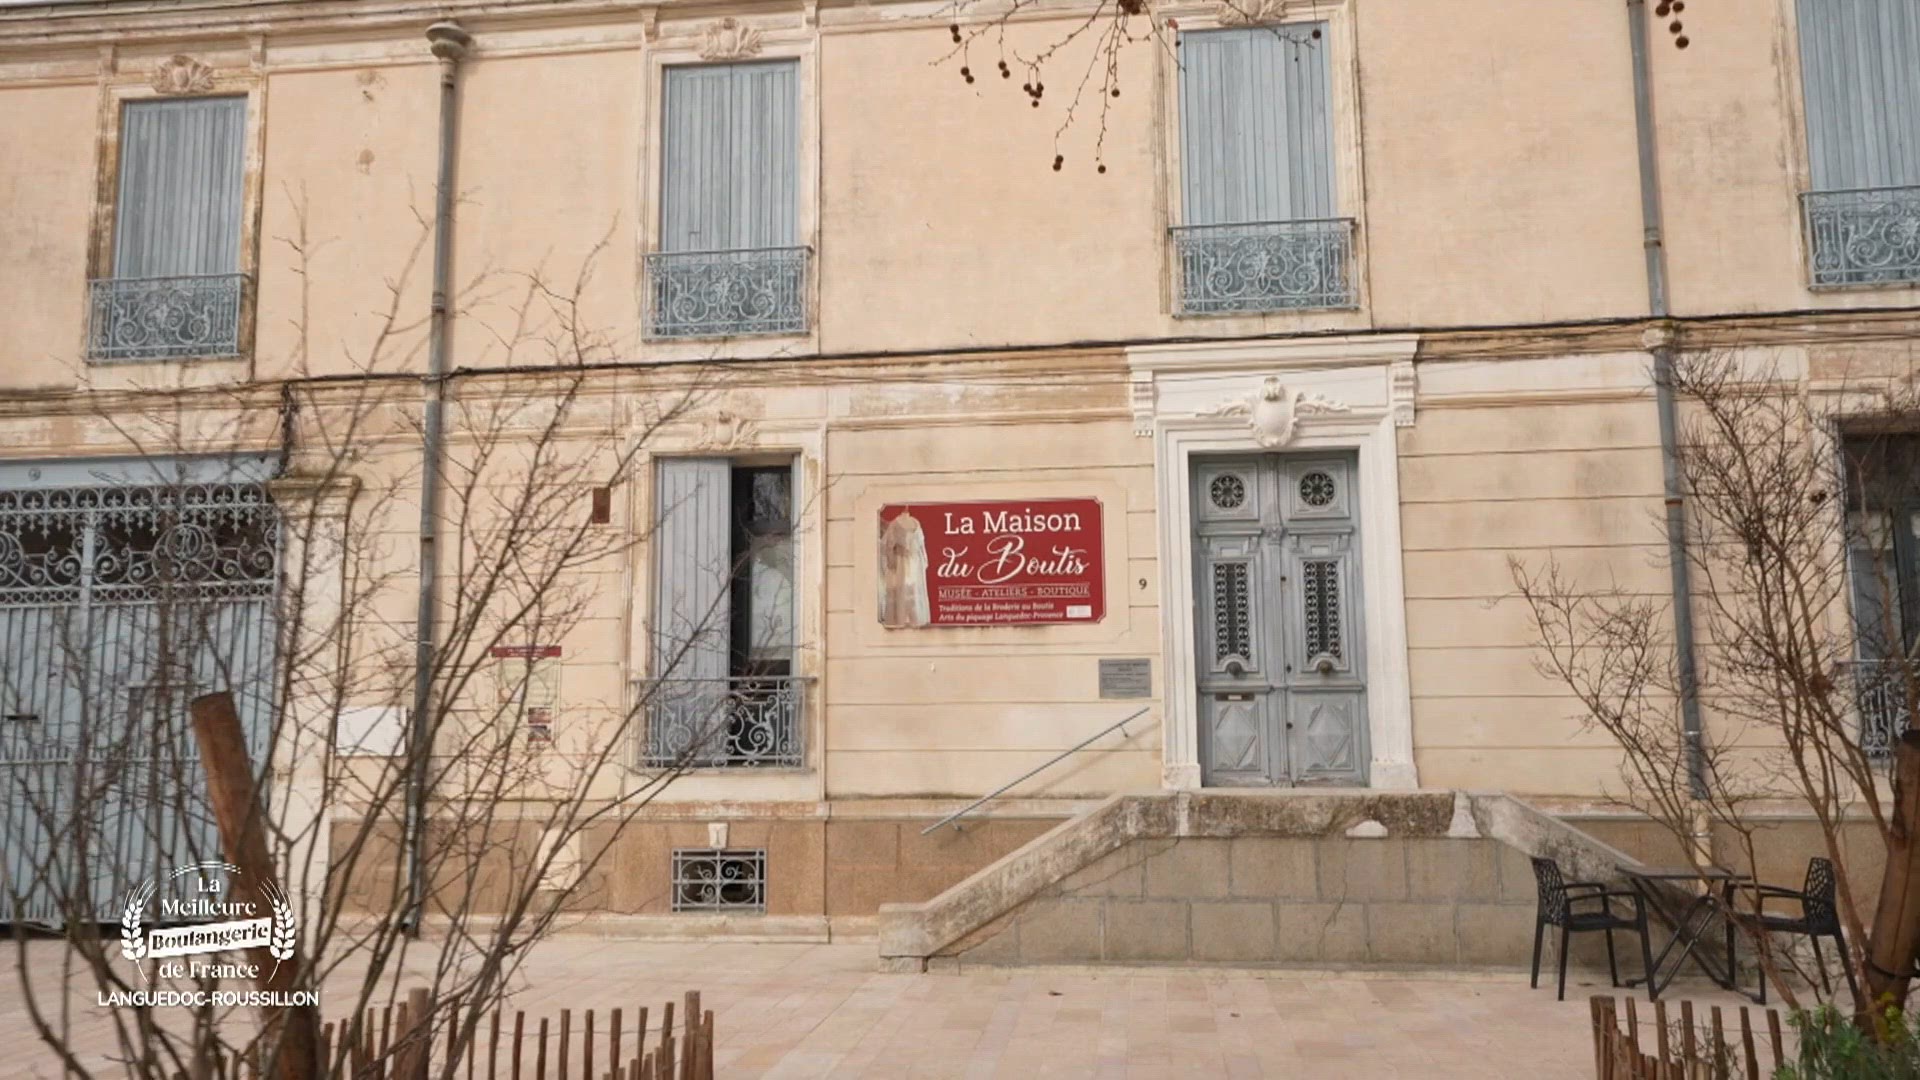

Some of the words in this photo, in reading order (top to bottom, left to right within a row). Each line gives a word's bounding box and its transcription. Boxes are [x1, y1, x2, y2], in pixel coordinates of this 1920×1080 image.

[944, 512, 975, 535] La
[982, 508, 1082, 534] Maison
[937, 547, 975, 578] du
[977, 534, 1090, 585] Boutis
[938, 588, 972, 598] MUSÉE
[981, 587, 1027, 598] ATELIERS
[1037, 585, 1090, 597] BOUTIQUE
[1138, 578, 1147, 590] 9
